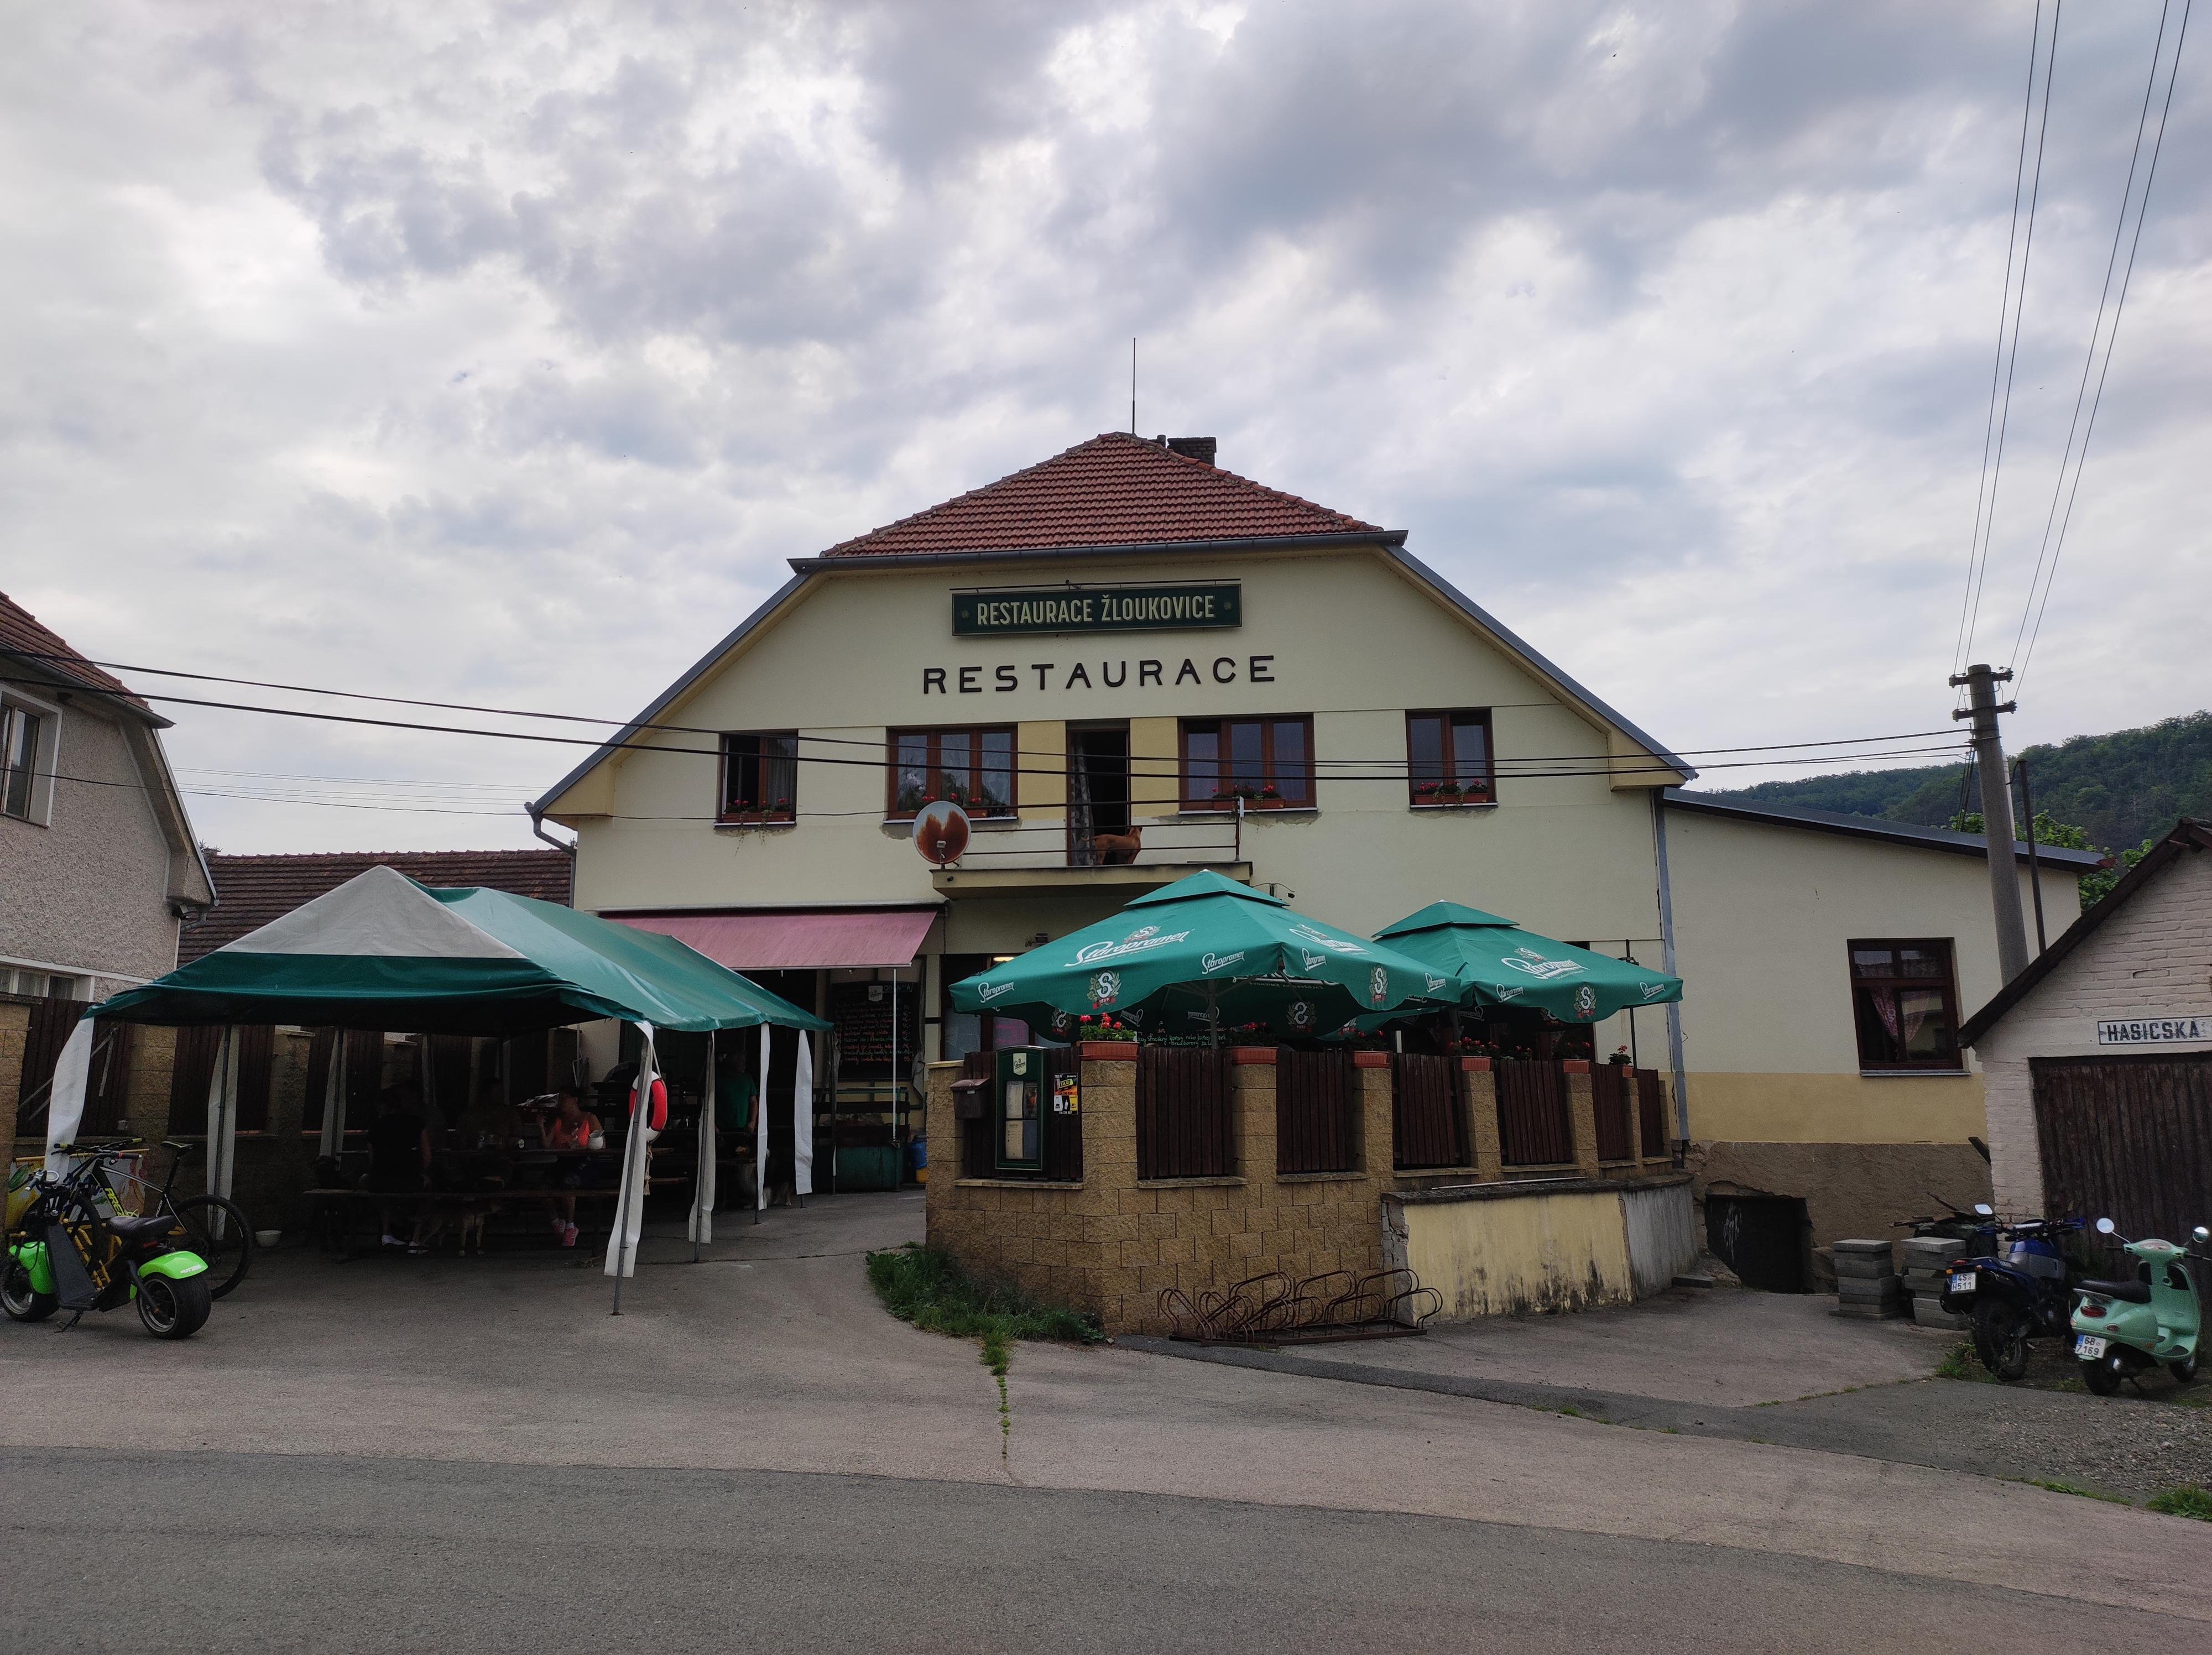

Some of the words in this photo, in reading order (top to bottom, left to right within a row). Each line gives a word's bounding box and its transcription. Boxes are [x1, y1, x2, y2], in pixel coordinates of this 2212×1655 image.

[977, 599, 1092, 625] RESTAURACE
[1101, 594, 1215, 622] ŽLOUKOVICE
[924, 655, 1275, 693] RESTAURACE
[1063, 930, 1192, 967] Staropramen
[1201, 951, 1245, 974] Staropramen
[978, 982, 1015, 1004] Staropramen
[1952, 1282, 1971, 1291] H511
[2077, 1345, 2099, 1355] 7169
